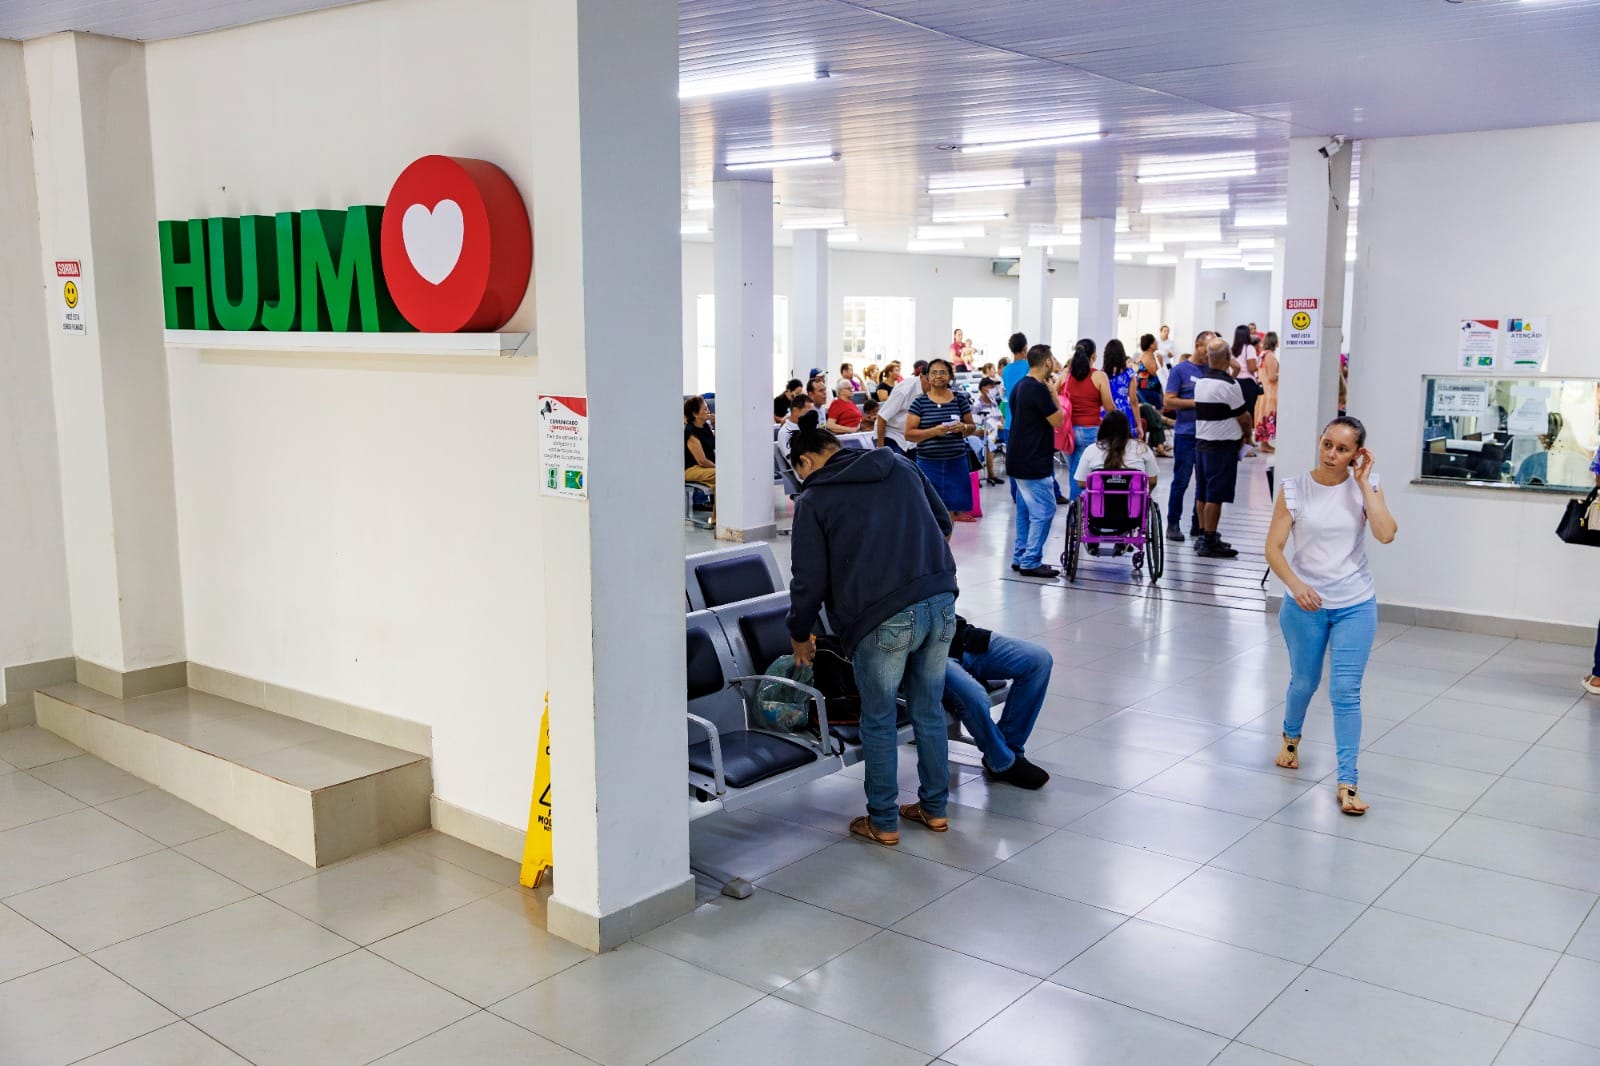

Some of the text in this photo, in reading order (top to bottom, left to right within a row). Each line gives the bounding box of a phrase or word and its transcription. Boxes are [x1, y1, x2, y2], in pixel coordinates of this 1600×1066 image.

[57, 263, 78, 275] SORRIA
[158, 205, 380, 332] HUJM
[1288, 299, 1315, 308] SORRIA
